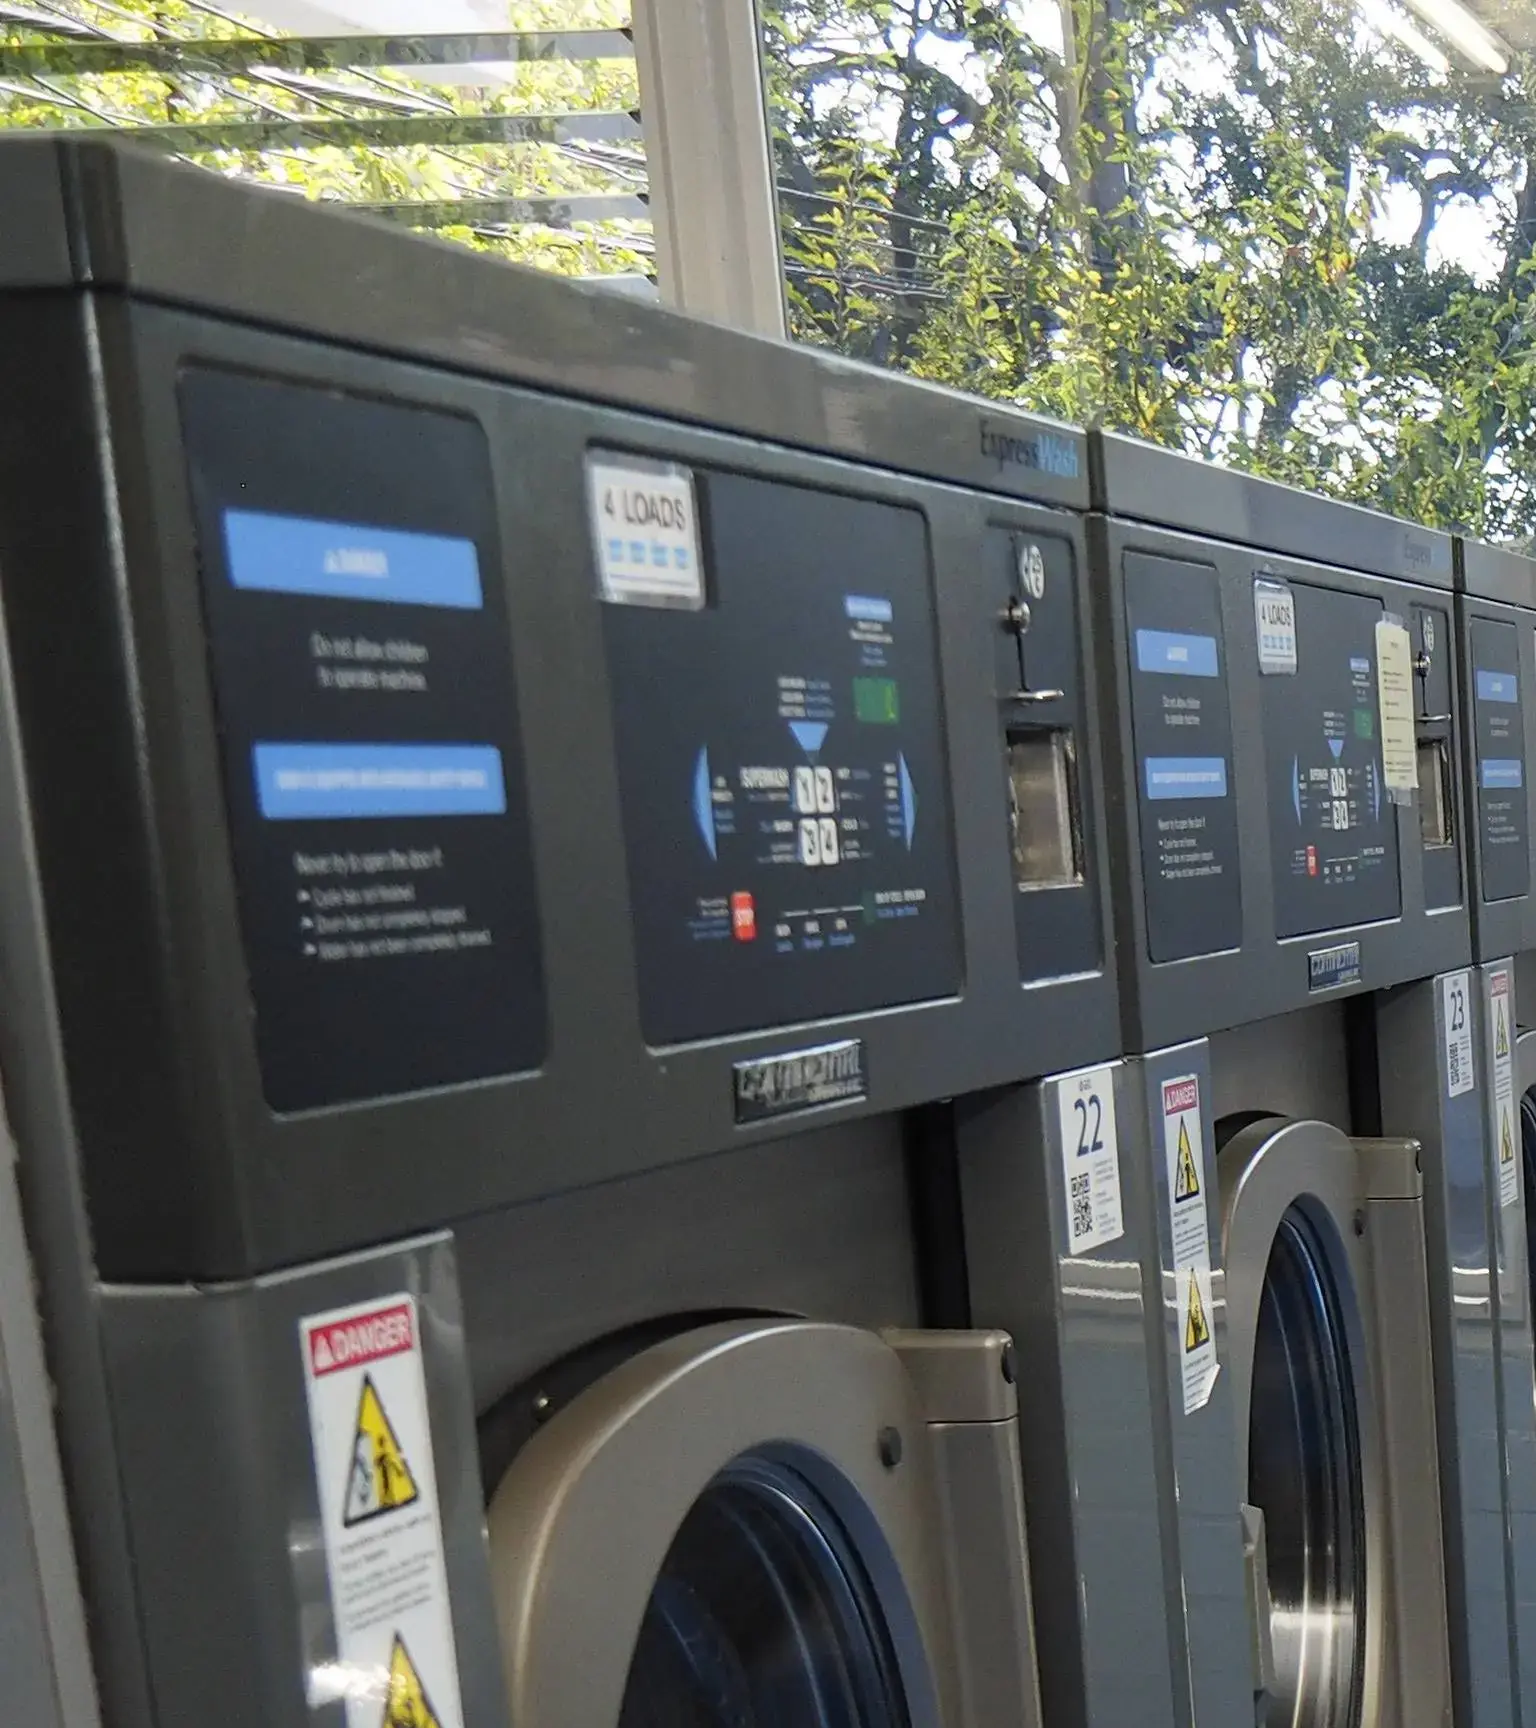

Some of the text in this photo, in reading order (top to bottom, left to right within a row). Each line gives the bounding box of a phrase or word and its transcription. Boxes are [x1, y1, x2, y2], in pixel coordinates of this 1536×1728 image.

[604, 486, 687, 531] 4 LOADS
[1450, 989, 1465, 1032] 23
[1073, 1094, 1104, 1158] 22
[331, 1313, 410, 1362] DANGER
